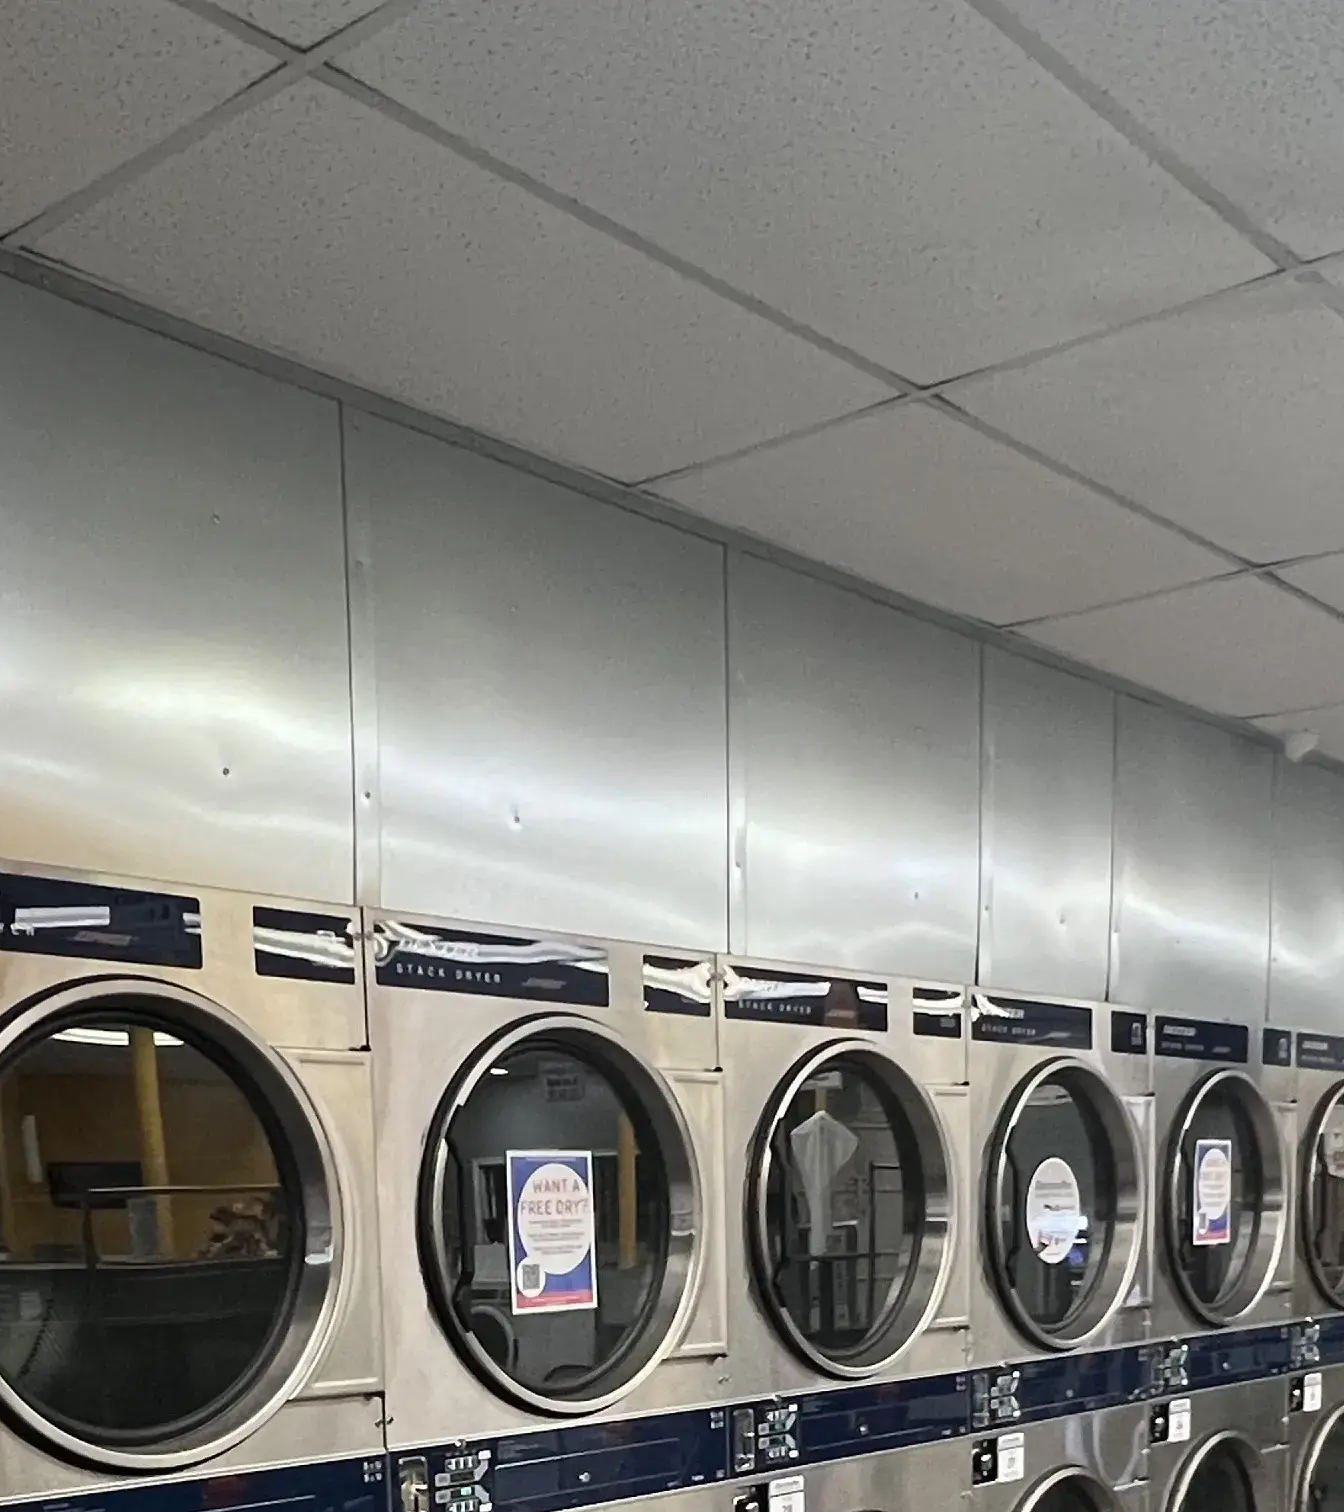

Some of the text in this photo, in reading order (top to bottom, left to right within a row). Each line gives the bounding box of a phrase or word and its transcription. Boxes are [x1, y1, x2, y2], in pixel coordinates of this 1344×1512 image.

[395, 962, 502, 984] STACK DRYER
[532, 1180, 581, 1194] WANT A
[521, 1201, 552, 1216] FREE
